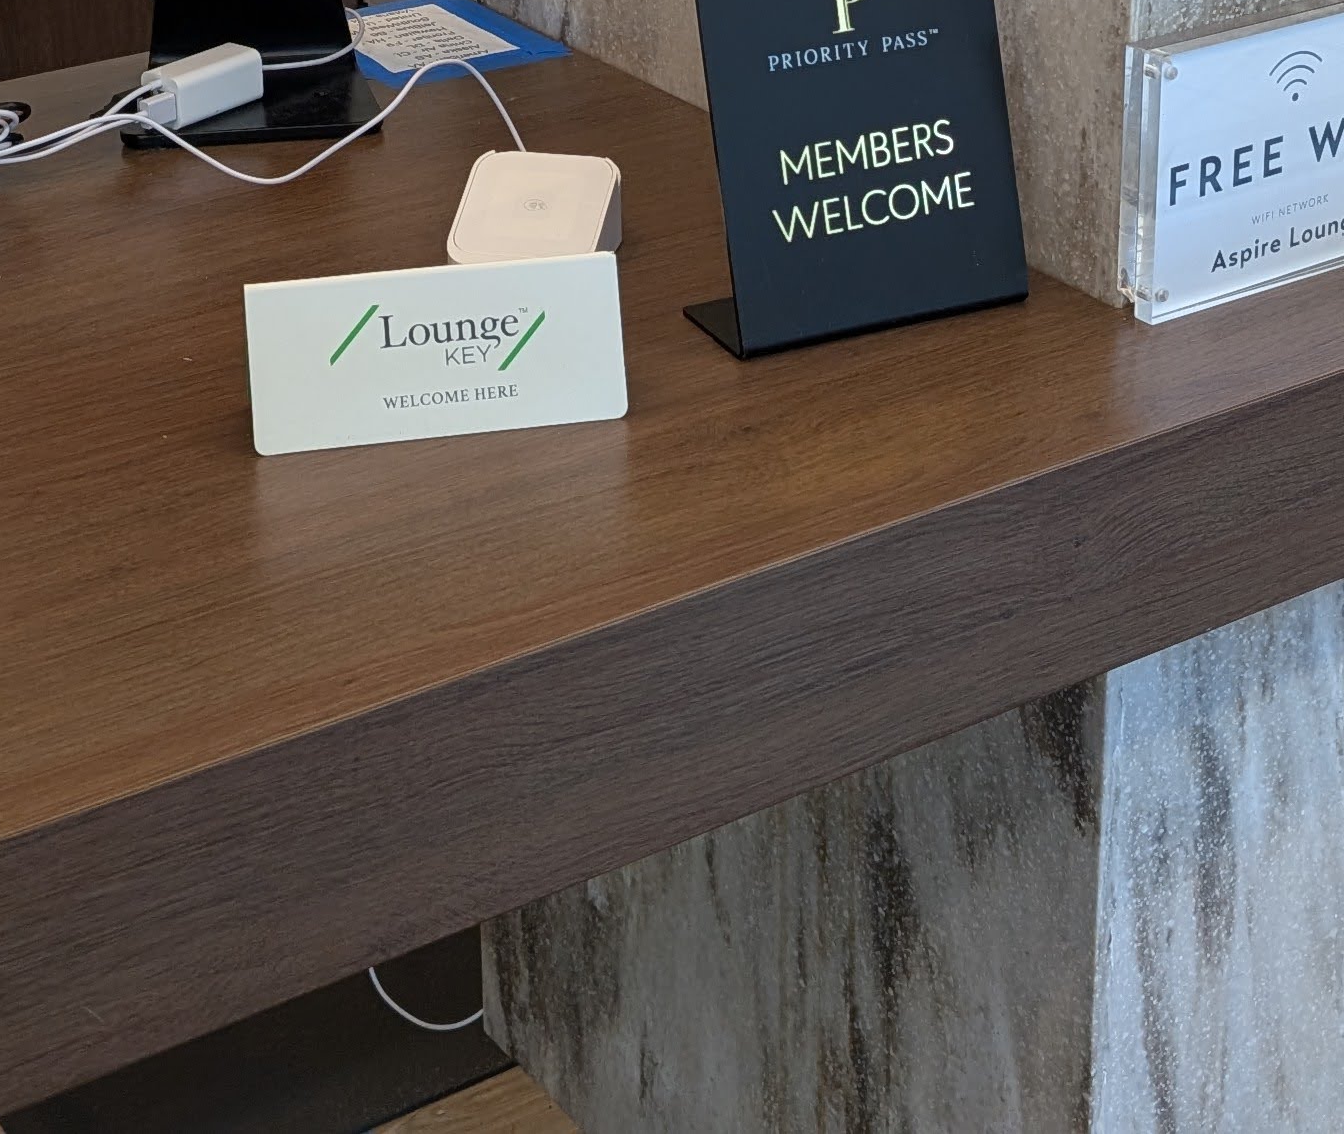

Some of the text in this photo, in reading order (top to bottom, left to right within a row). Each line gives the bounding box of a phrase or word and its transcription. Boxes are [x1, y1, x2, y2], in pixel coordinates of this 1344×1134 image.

[767, 39, 870, 72] PRIORITY
[779, 119, 955, 186] MEMBERS
[1168, 135, 1285, 207] FREE
[772, 171, 975, 243] WELCOME
[1251, 193, 1329, 225] WIFI NETWORK
[1210, 238, 1281, 273] Aspire
[444, 343, 492, 366] KEY
[383, 383, 519, 410] WELCOME HERE
